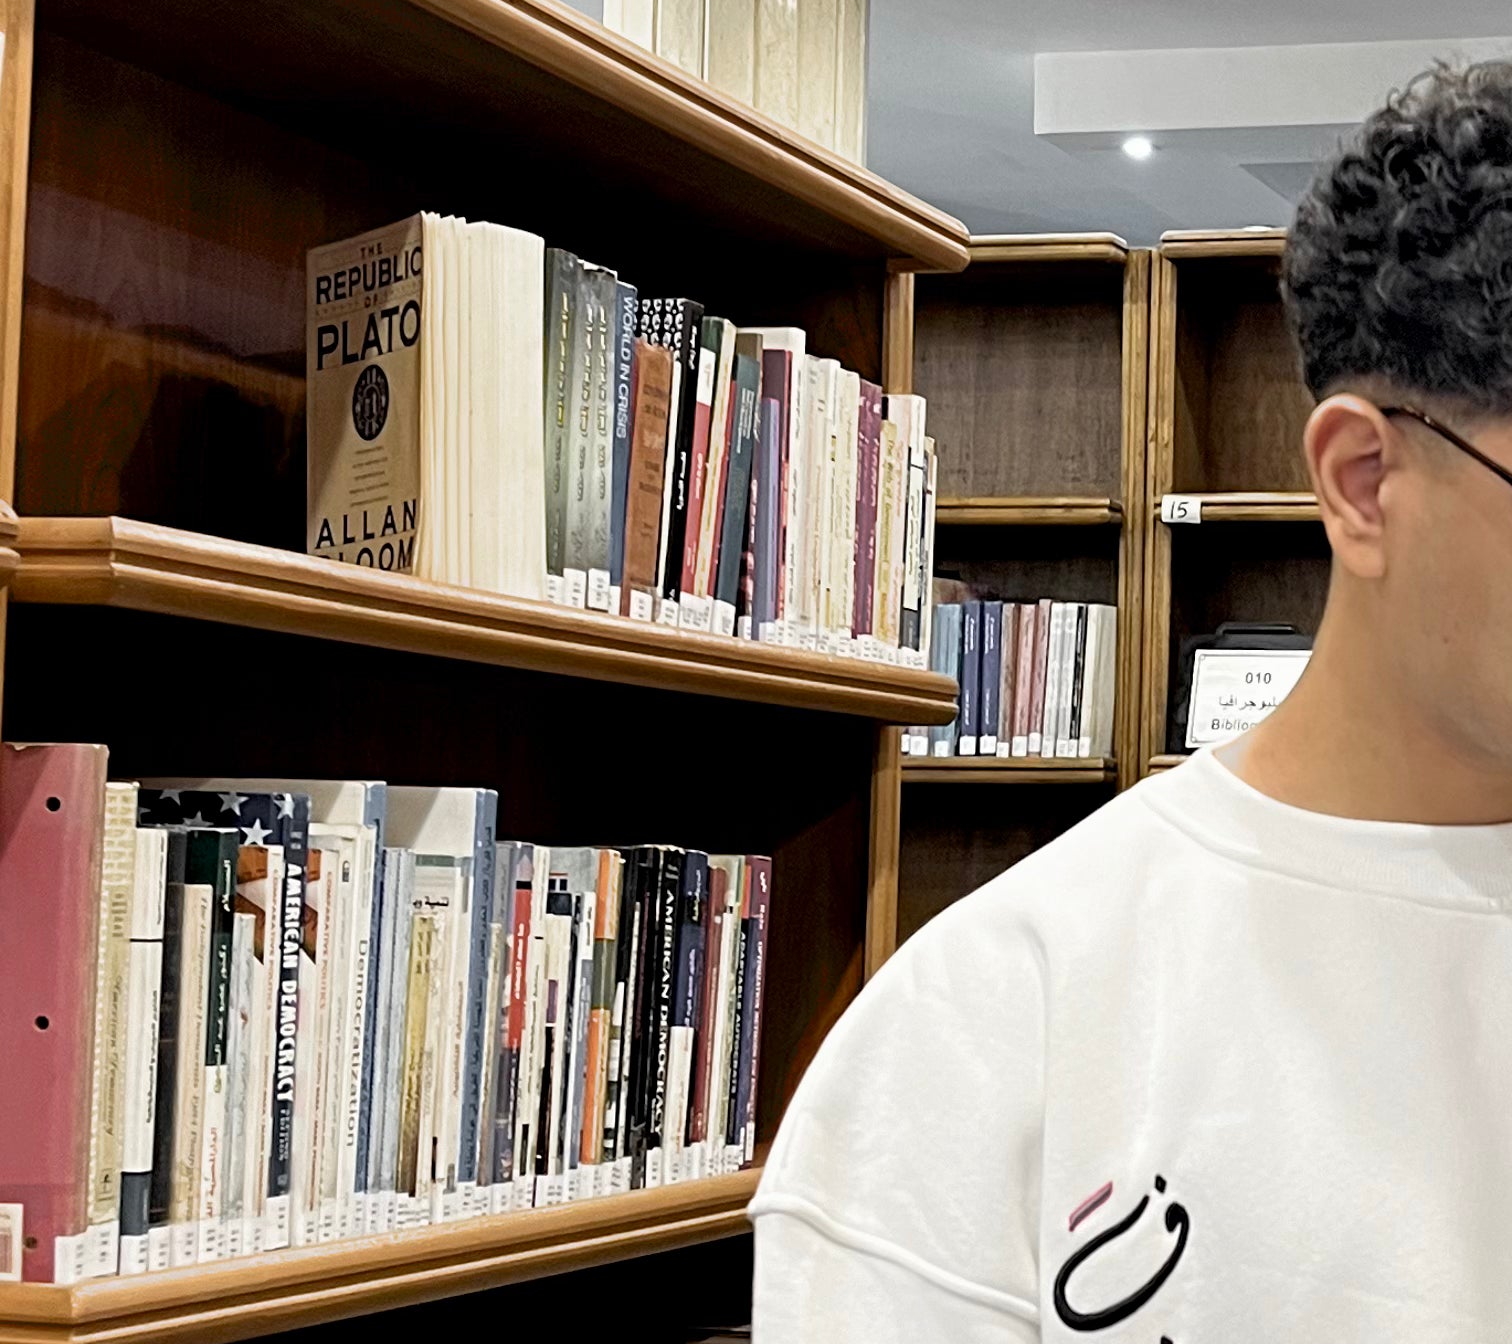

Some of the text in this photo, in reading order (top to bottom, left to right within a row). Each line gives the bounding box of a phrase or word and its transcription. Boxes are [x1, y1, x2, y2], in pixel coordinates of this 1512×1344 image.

[315, 246, 422, 305] REPUBLIC
[361, 242, 384, 257] THE
[315, 300, 421, 371] PLATO
[616, 295, 635, 440] WORLD IN CRISIS
[315, 499, 418, 550] ALLAN
[1170, 501, 1190, 519] 15
[1245, 672, 1272, 685] 010
[277, 863, 303, 1102] AMERICAN DEMOCRACY
[654, 889, 676, 1137] AMERICAN DEMOCRACY
[731, 930, 747, 1094] ADAPTABLE AUTOCRATS
[346, 939, 370, 1148] Democratization
